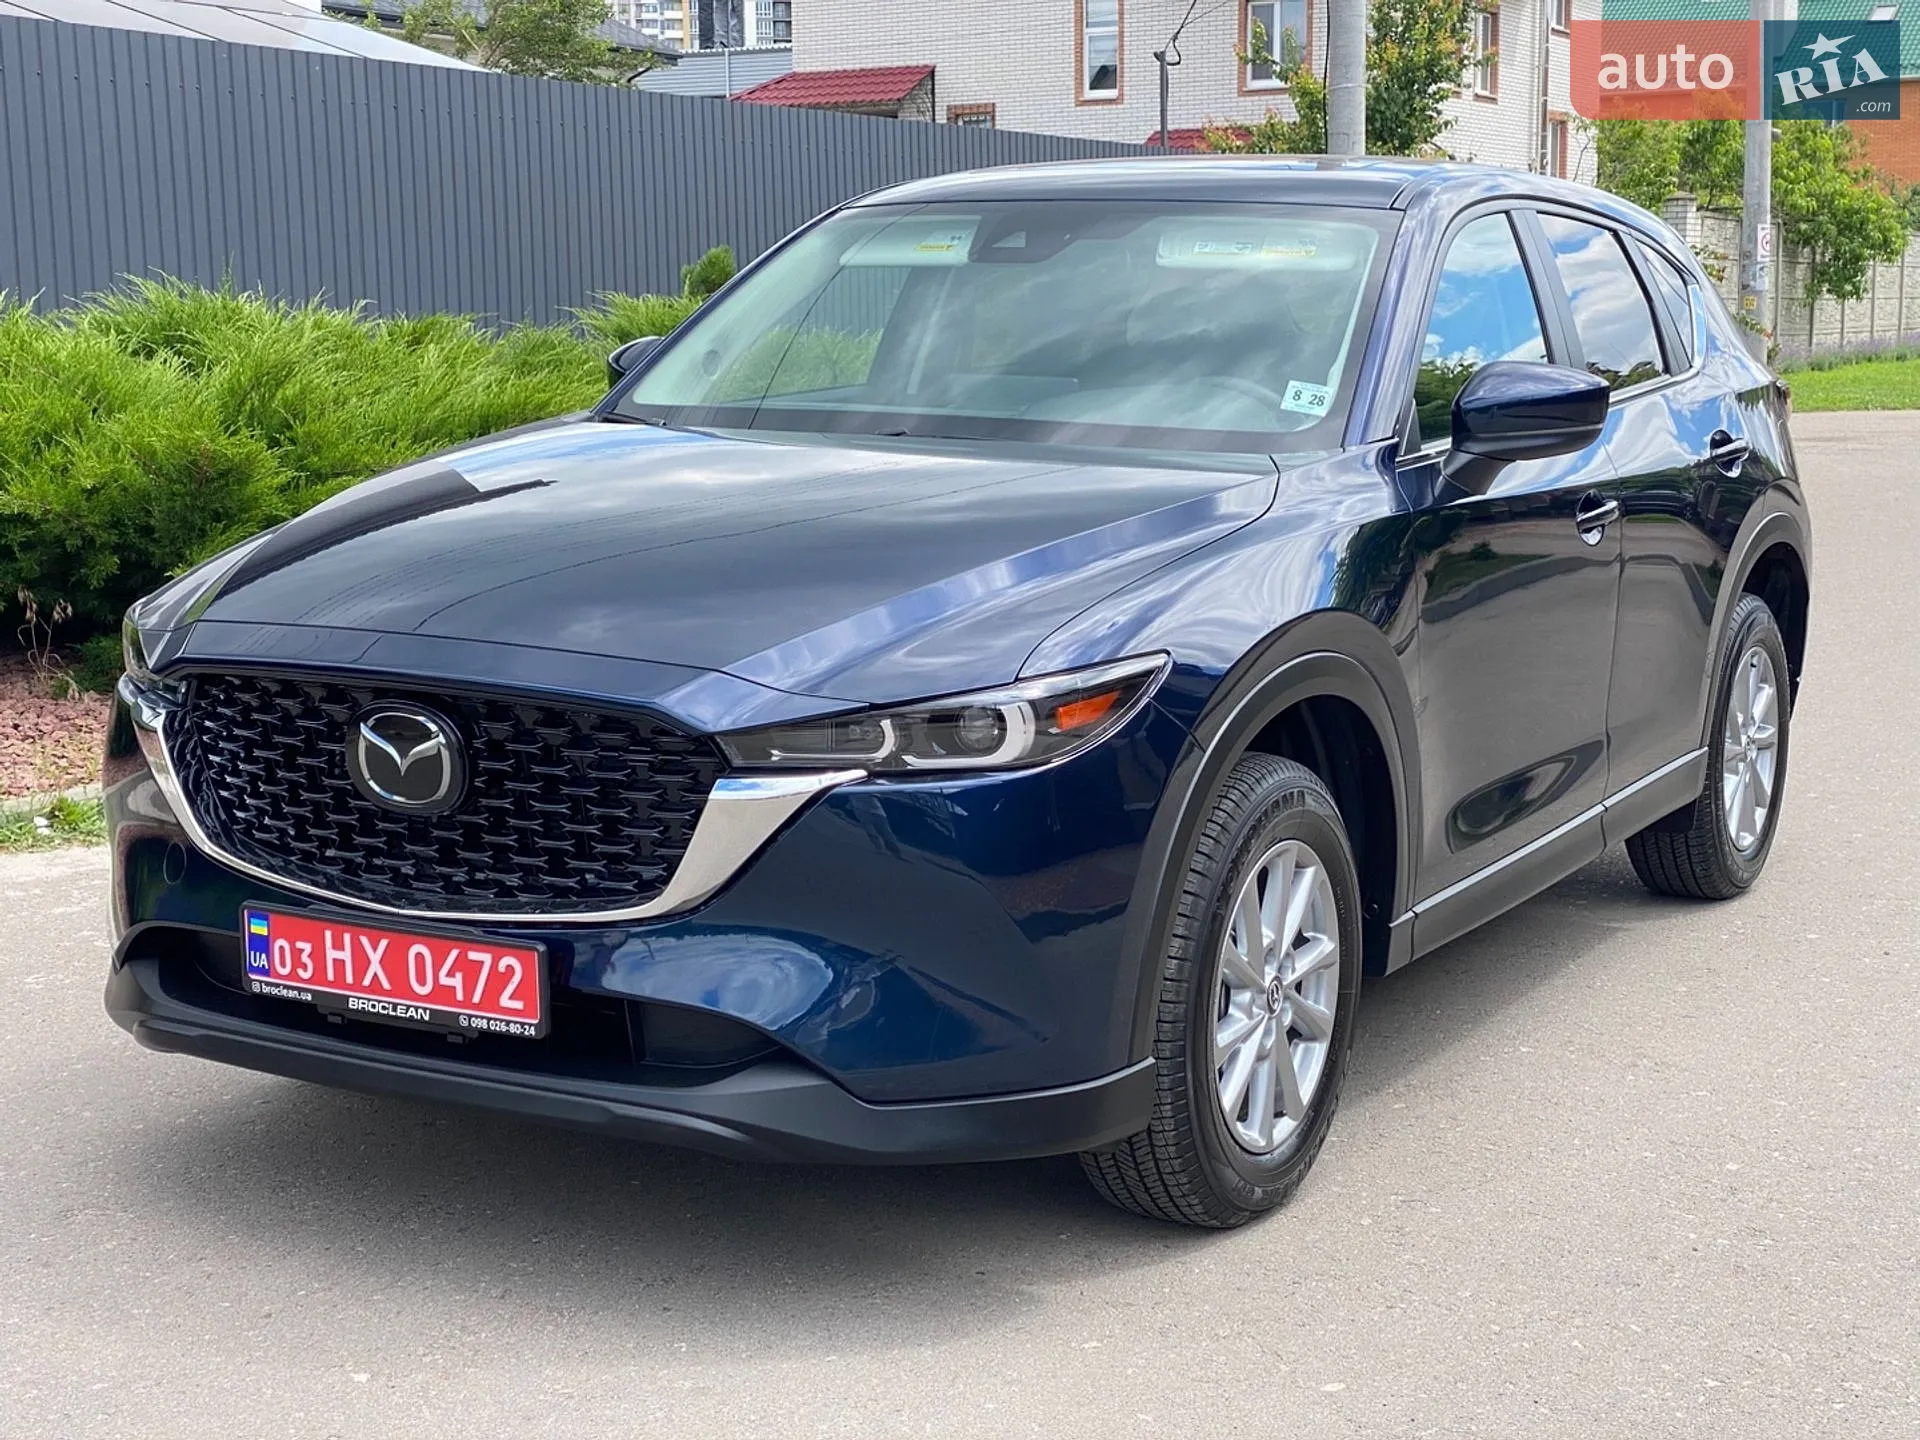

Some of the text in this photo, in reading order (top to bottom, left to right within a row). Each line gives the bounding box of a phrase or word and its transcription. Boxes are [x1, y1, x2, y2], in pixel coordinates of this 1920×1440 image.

[1292, 389, 1303, 402] 8
[1308, 394, 1326, 407] 28
[250, 951, 269, 970] UA
[273, 929, 525, 1011] 03 HX 0472
[261, 982, 312, 1002] broclean.ua
[348, 997, 431, 1021] BROCLEAN
[470, 1017, 536, 1037] 098 026-80-24
